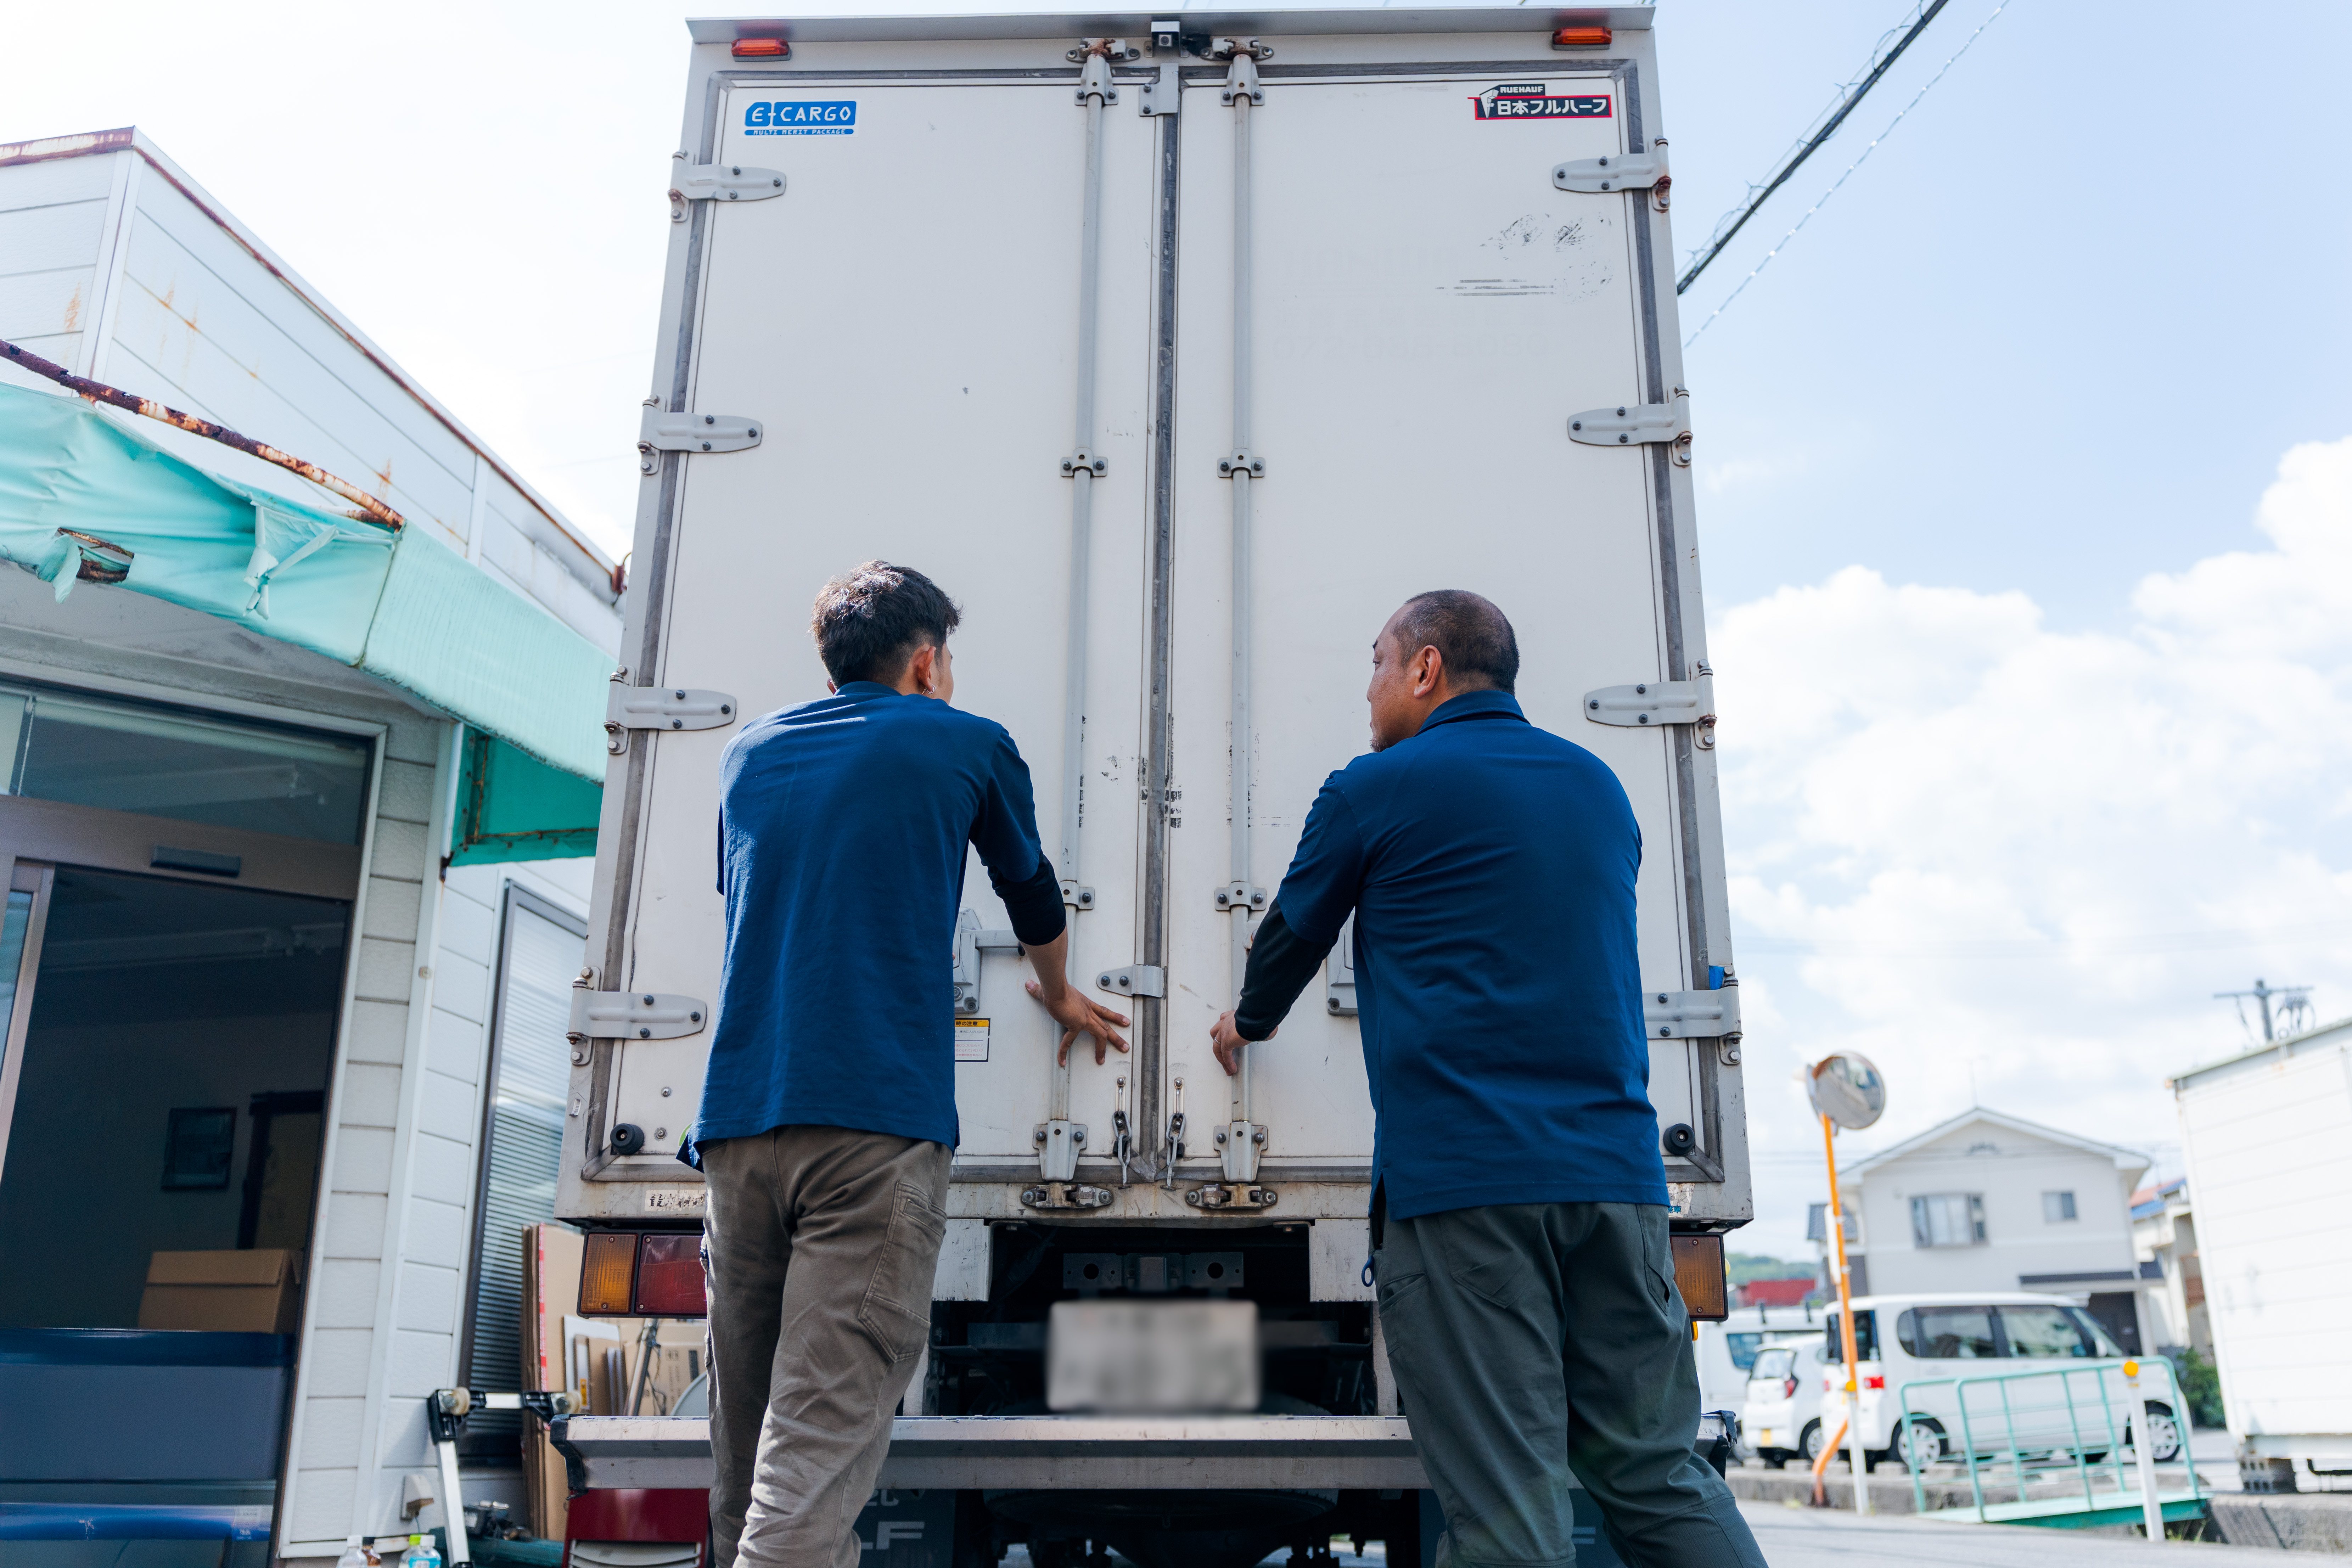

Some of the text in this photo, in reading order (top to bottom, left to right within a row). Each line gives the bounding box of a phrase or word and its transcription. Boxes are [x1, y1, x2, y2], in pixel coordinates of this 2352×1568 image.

[752, 106, 851, 122] E-CARGO
[1497, 99, 1606, 115] 日本フルハーフ
